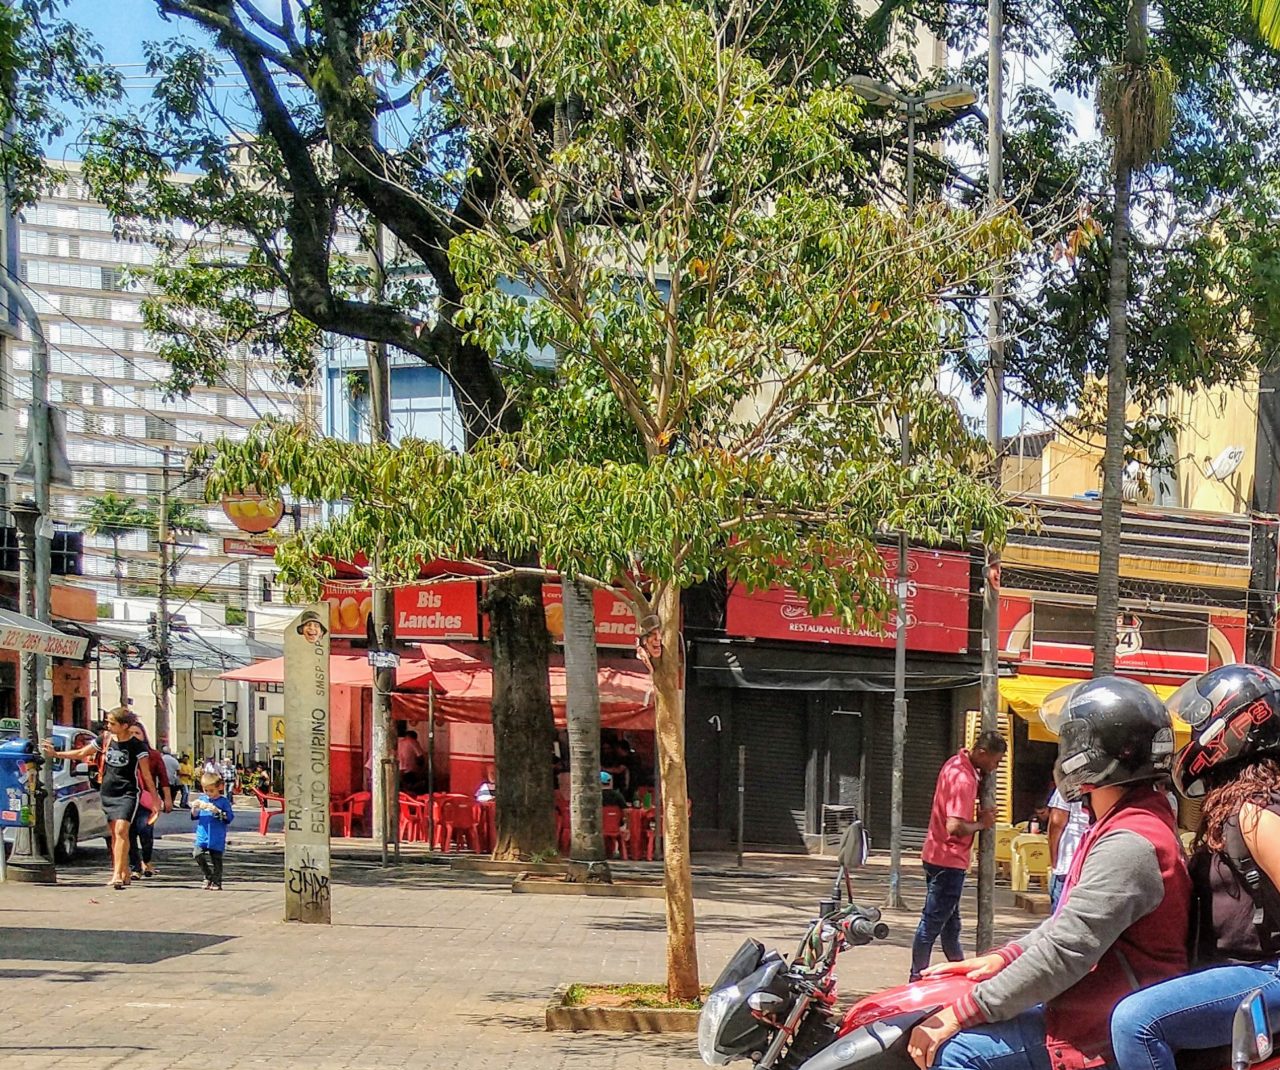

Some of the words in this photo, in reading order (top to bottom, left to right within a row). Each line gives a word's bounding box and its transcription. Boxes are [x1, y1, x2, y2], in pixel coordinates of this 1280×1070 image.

[416, 590, 442, 608] Bis
[398, 611, 462, 629] Lanches
[315, 665, 325, 697] SMSP
[4, 720, 20, 729] TAX
[311, 708, 327, 774] QUIRINO
[311, 780, 326, 834] BENTO
